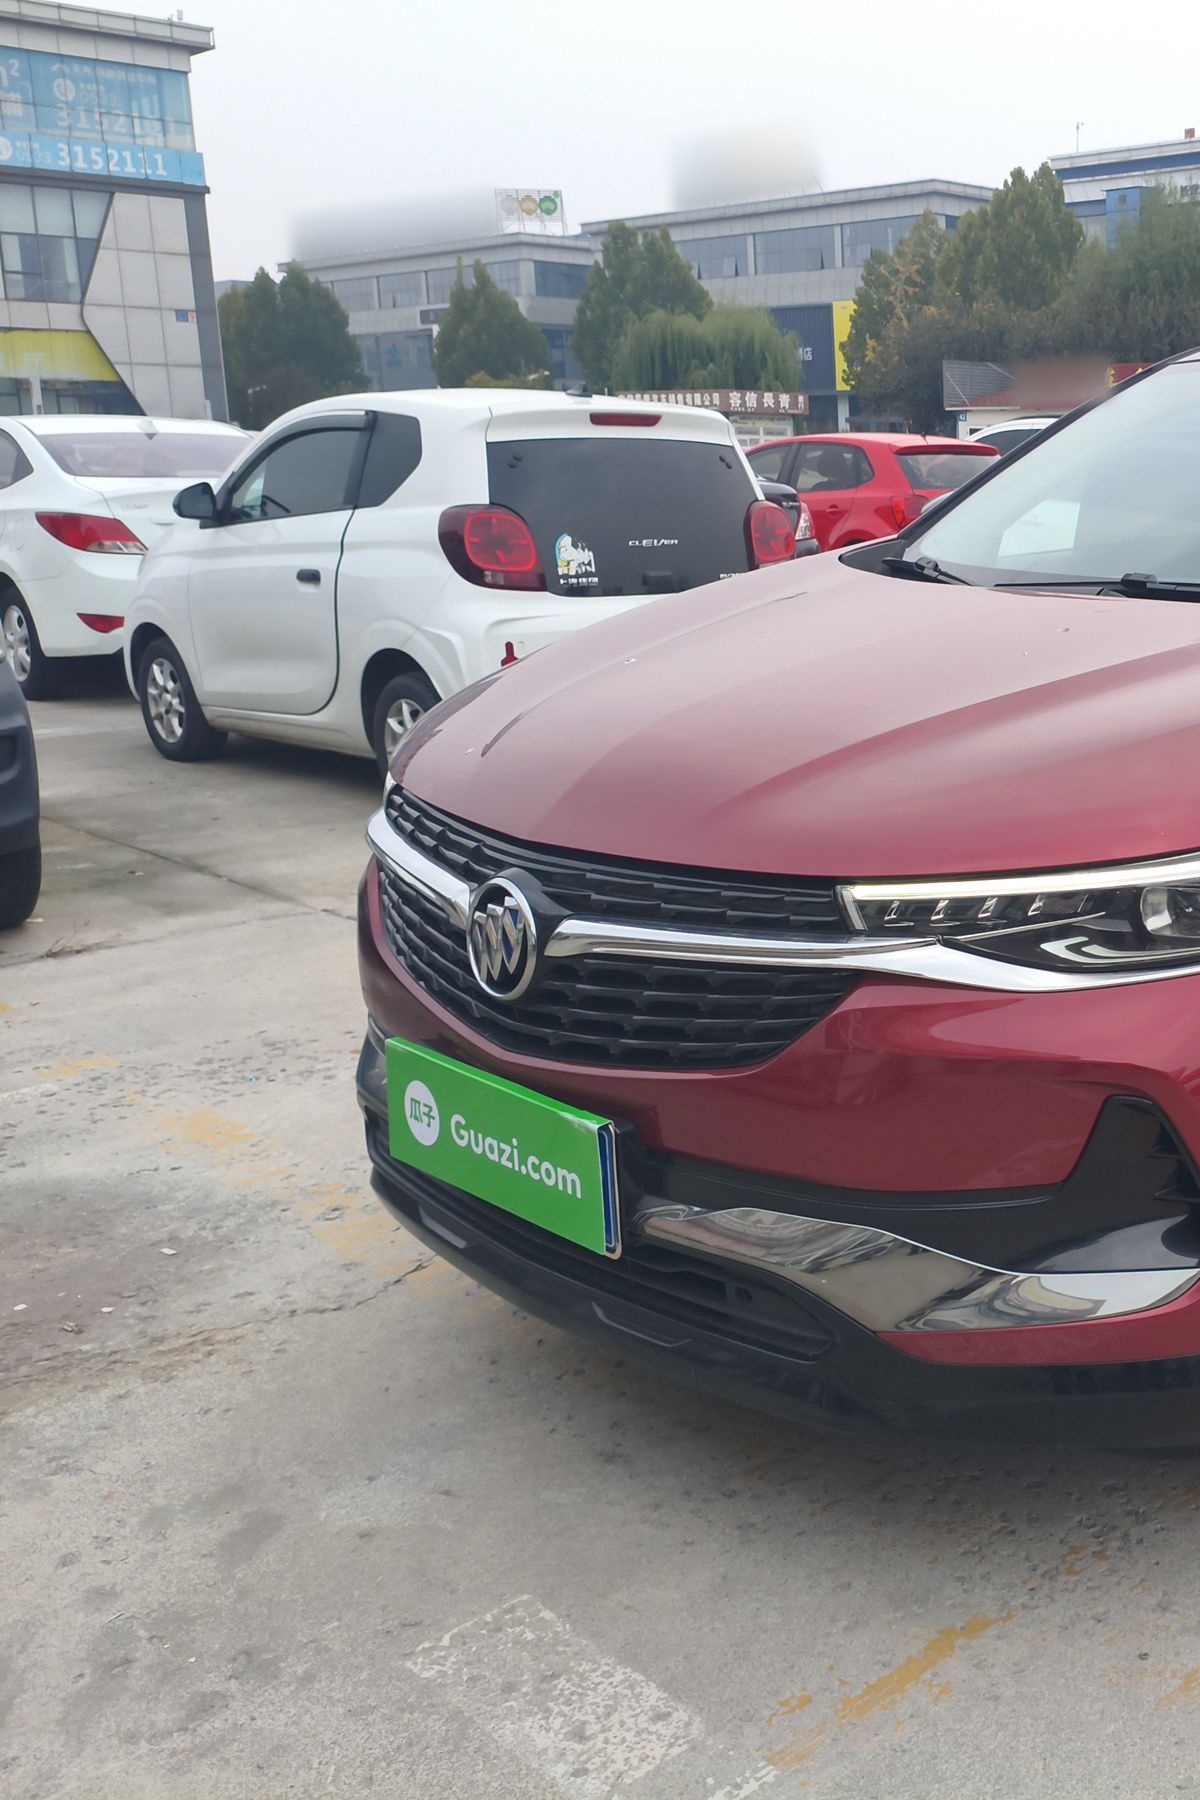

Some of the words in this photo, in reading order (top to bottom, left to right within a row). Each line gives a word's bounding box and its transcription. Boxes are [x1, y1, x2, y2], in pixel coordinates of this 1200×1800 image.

[56, 143, 167, 176] 3152111
[628, 538, 678, 547] CLEVER
[409, 1097, 436, 1128] 瓜子
[450, 1113, 582, 1199] Guazi.com
